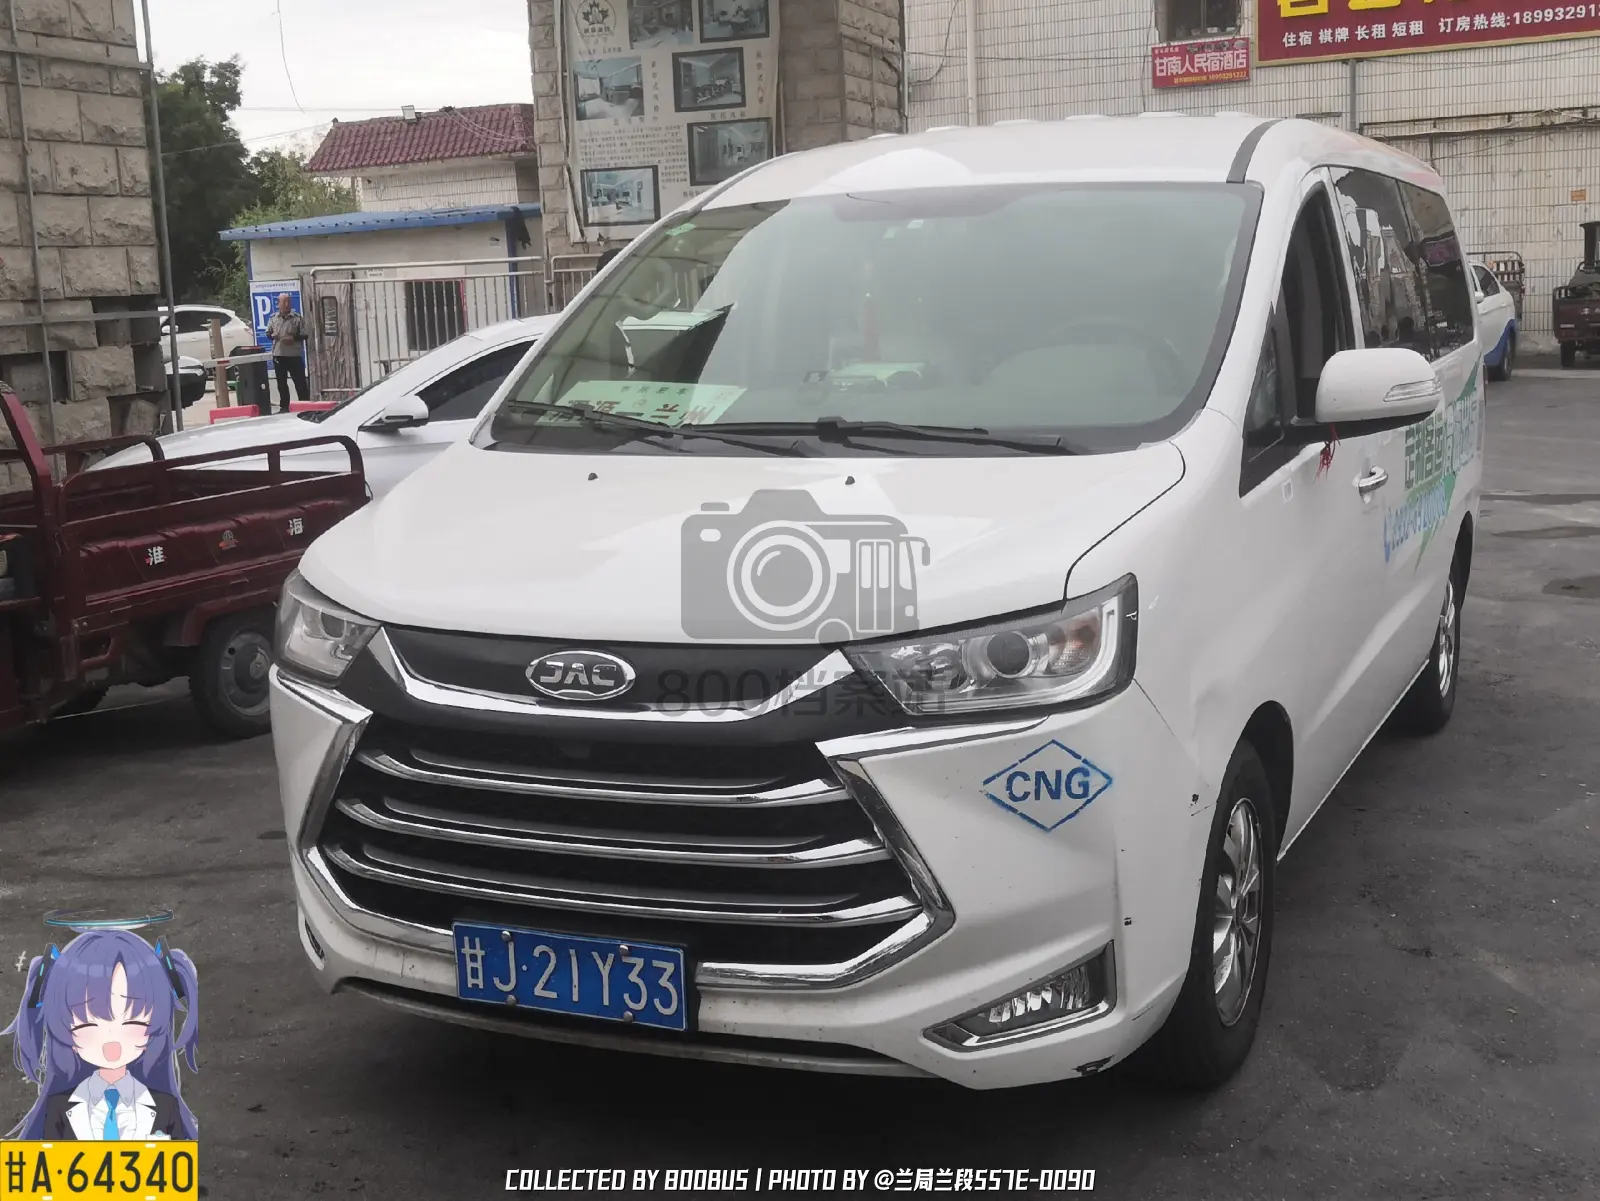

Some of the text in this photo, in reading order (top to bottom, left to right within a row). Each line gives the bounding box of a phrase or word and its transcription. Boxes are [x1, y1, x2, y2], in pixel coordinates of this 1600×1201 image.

[1282, 30, 1313, 48] 住宿
[1318, 27, 1350, 44] 棋牌
[1355, 23, 1386, 41] 长租
[1392, 20, 1424, 37] 短租
[1154, 49, 1247, 77] 甘南人民宿酒店
[148, 517, 304, 566] 淮 海
[540, 660, 617, 687] JAC
[1006, 766, 1090, 802] CNG
